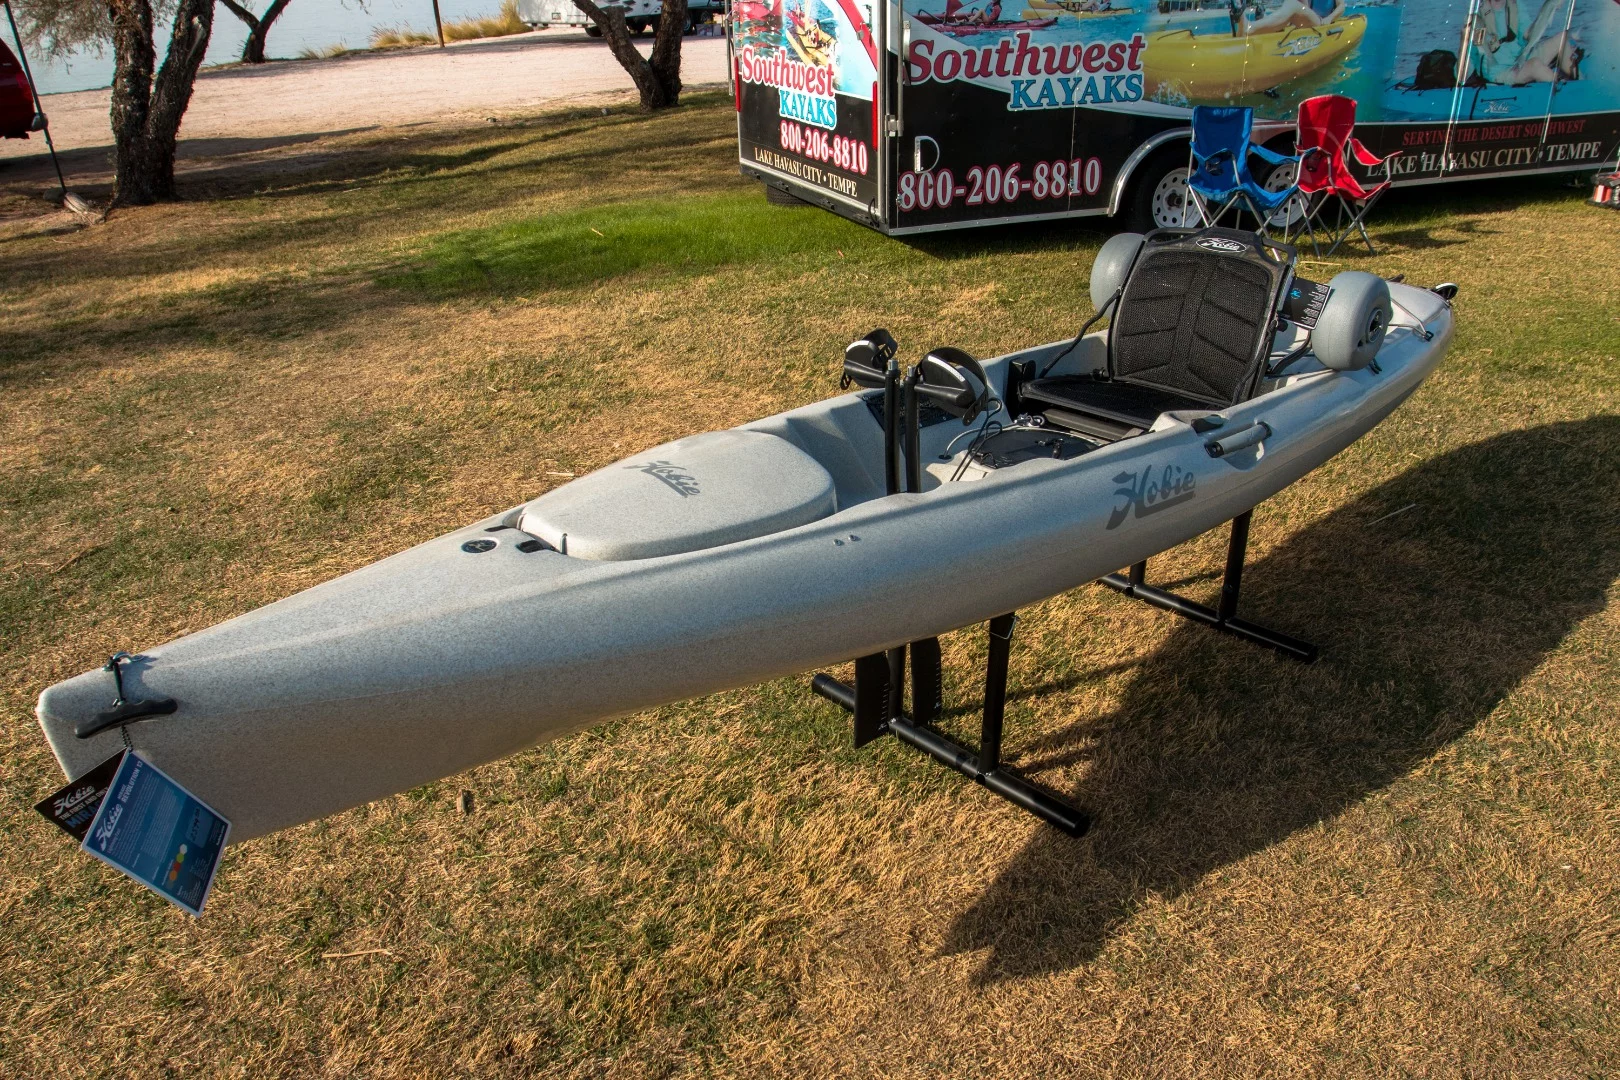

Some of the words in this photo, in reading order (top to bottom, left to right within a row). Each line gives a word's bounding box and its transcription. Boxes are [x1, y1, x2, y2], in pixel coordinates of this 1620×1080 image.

[742, 47, 834, 97] Southwest
[903, 32, 1145, 82] Southwest
[779, 89, 837, 128] KAYAKS
[1010, 73, 1143, 108] KAYAKS
[780, 120, 867, 175] 800-206-8810
[1456, 127, 1479, 142] THE
[1481, 124, 1523, 141] DESERT
[755, 147, 774, 166] LAKE
[774, 153, 802, 176] HAVASU
[803, 164, 823, 184] CITY
[828, 172, 858, 197] TEMPE
[1494, 147, 1537, 167] CITY
[1546, 141, 1602, 161] TEMPE
[899, 157, 1101, 212] 800-206-8810
[1200, 238, 1240, 251] Hobie
[622, 460, 701, 499] Hobie
[1105, 464, 1197, 531] Hobie
[53, 784, 96, 817] Hobie
[69, 802, 86, 814] FIRST
[85, 795, 98, 804] AND
[120, 767, 141, 803] REVOLUTION
[96, 803, 123, 852] Hobie
